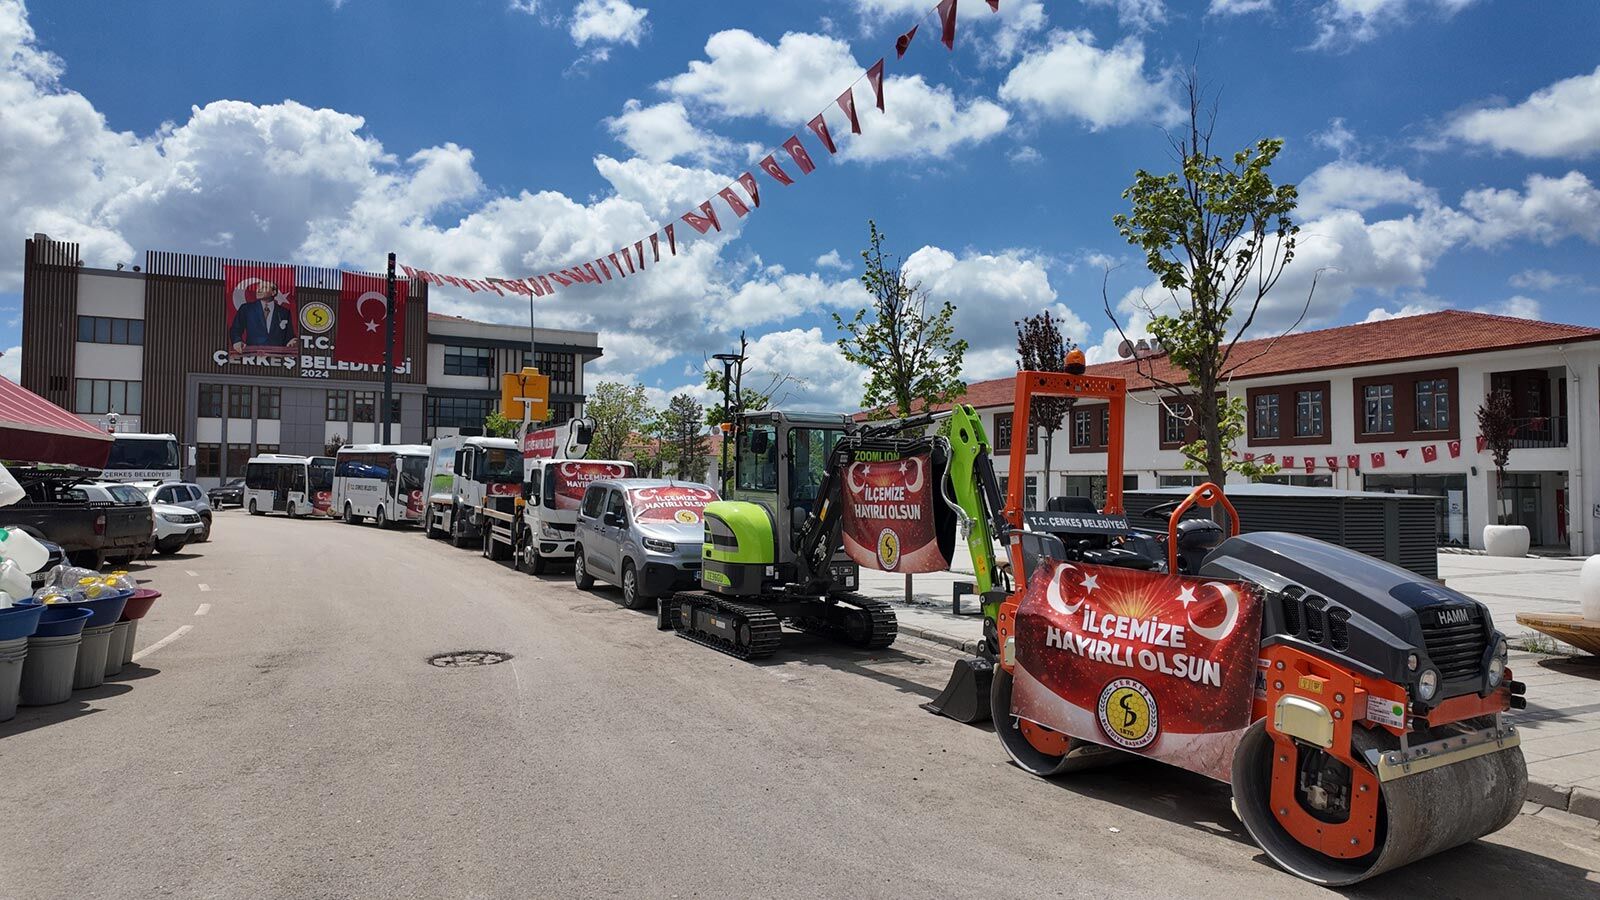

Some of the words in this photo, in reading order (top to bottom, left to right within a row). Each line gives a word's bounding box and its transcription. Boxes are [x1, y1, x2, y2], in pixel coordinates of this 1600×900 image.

[300, 335, 335, 350] T.C.
[300, 355, 412, 375] BELEDYSİ
[301, 369, 330, 379] 2024
[854, 450, 900, 462] ZOOMLION
[577, 472, 612, 481] İLÇEMİZE
[566, 480, 590, 488] HAYIR
[655, 494, 698, 502] İLÇEMİZE
[864, 483, 905, 502] İLÇEMİZE
[645, 501, 683, 510] HAYIRLI
[854, 504, 888, 519] HAYIRLI
[888, 504, 921, 519] OLSUN
[1030, 516, 1049, 526] T.C.
[1049, 517, 1081, 528] ÇERKEŞ
[1082, 518, 1129, 530] BELEDİYESİ
[1437, 608, 1470, 625] HAMM
[1082, 604, 1187, 648] İLÇEMİZE
[1045, 625, 1134, 668] HAYIRLI
[1137, 649, 1221, 687] OLSUN
